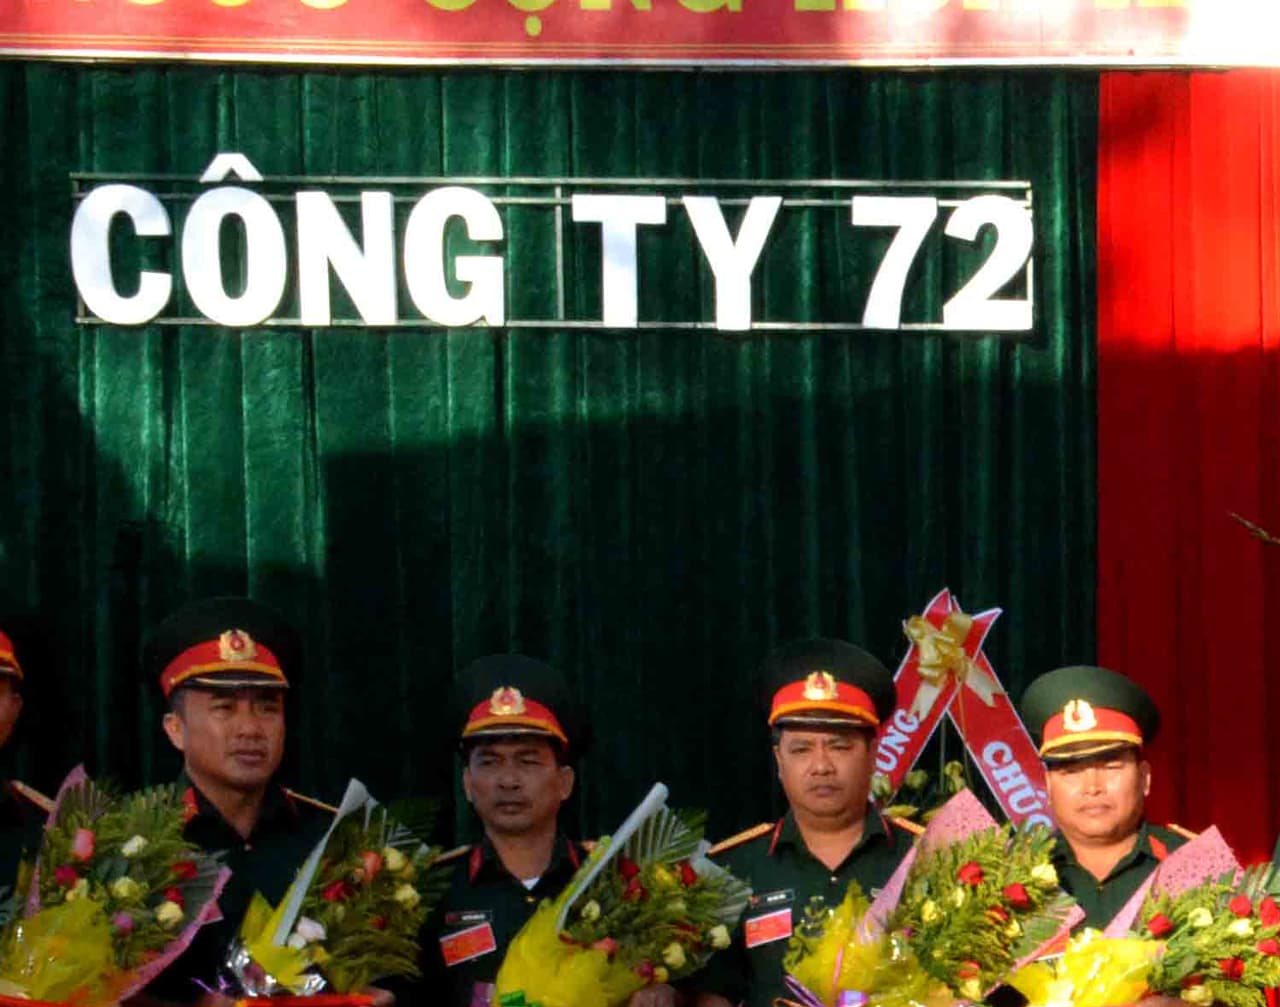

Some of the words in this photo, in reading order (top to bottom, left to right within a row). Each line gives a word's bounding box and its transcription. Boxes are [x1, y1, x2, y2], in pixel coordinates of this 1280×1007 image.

[69, 152, 506, 328] CÔNG
[572, 196, 782, 331] TY
[851, 192, 1034, 332] 72
